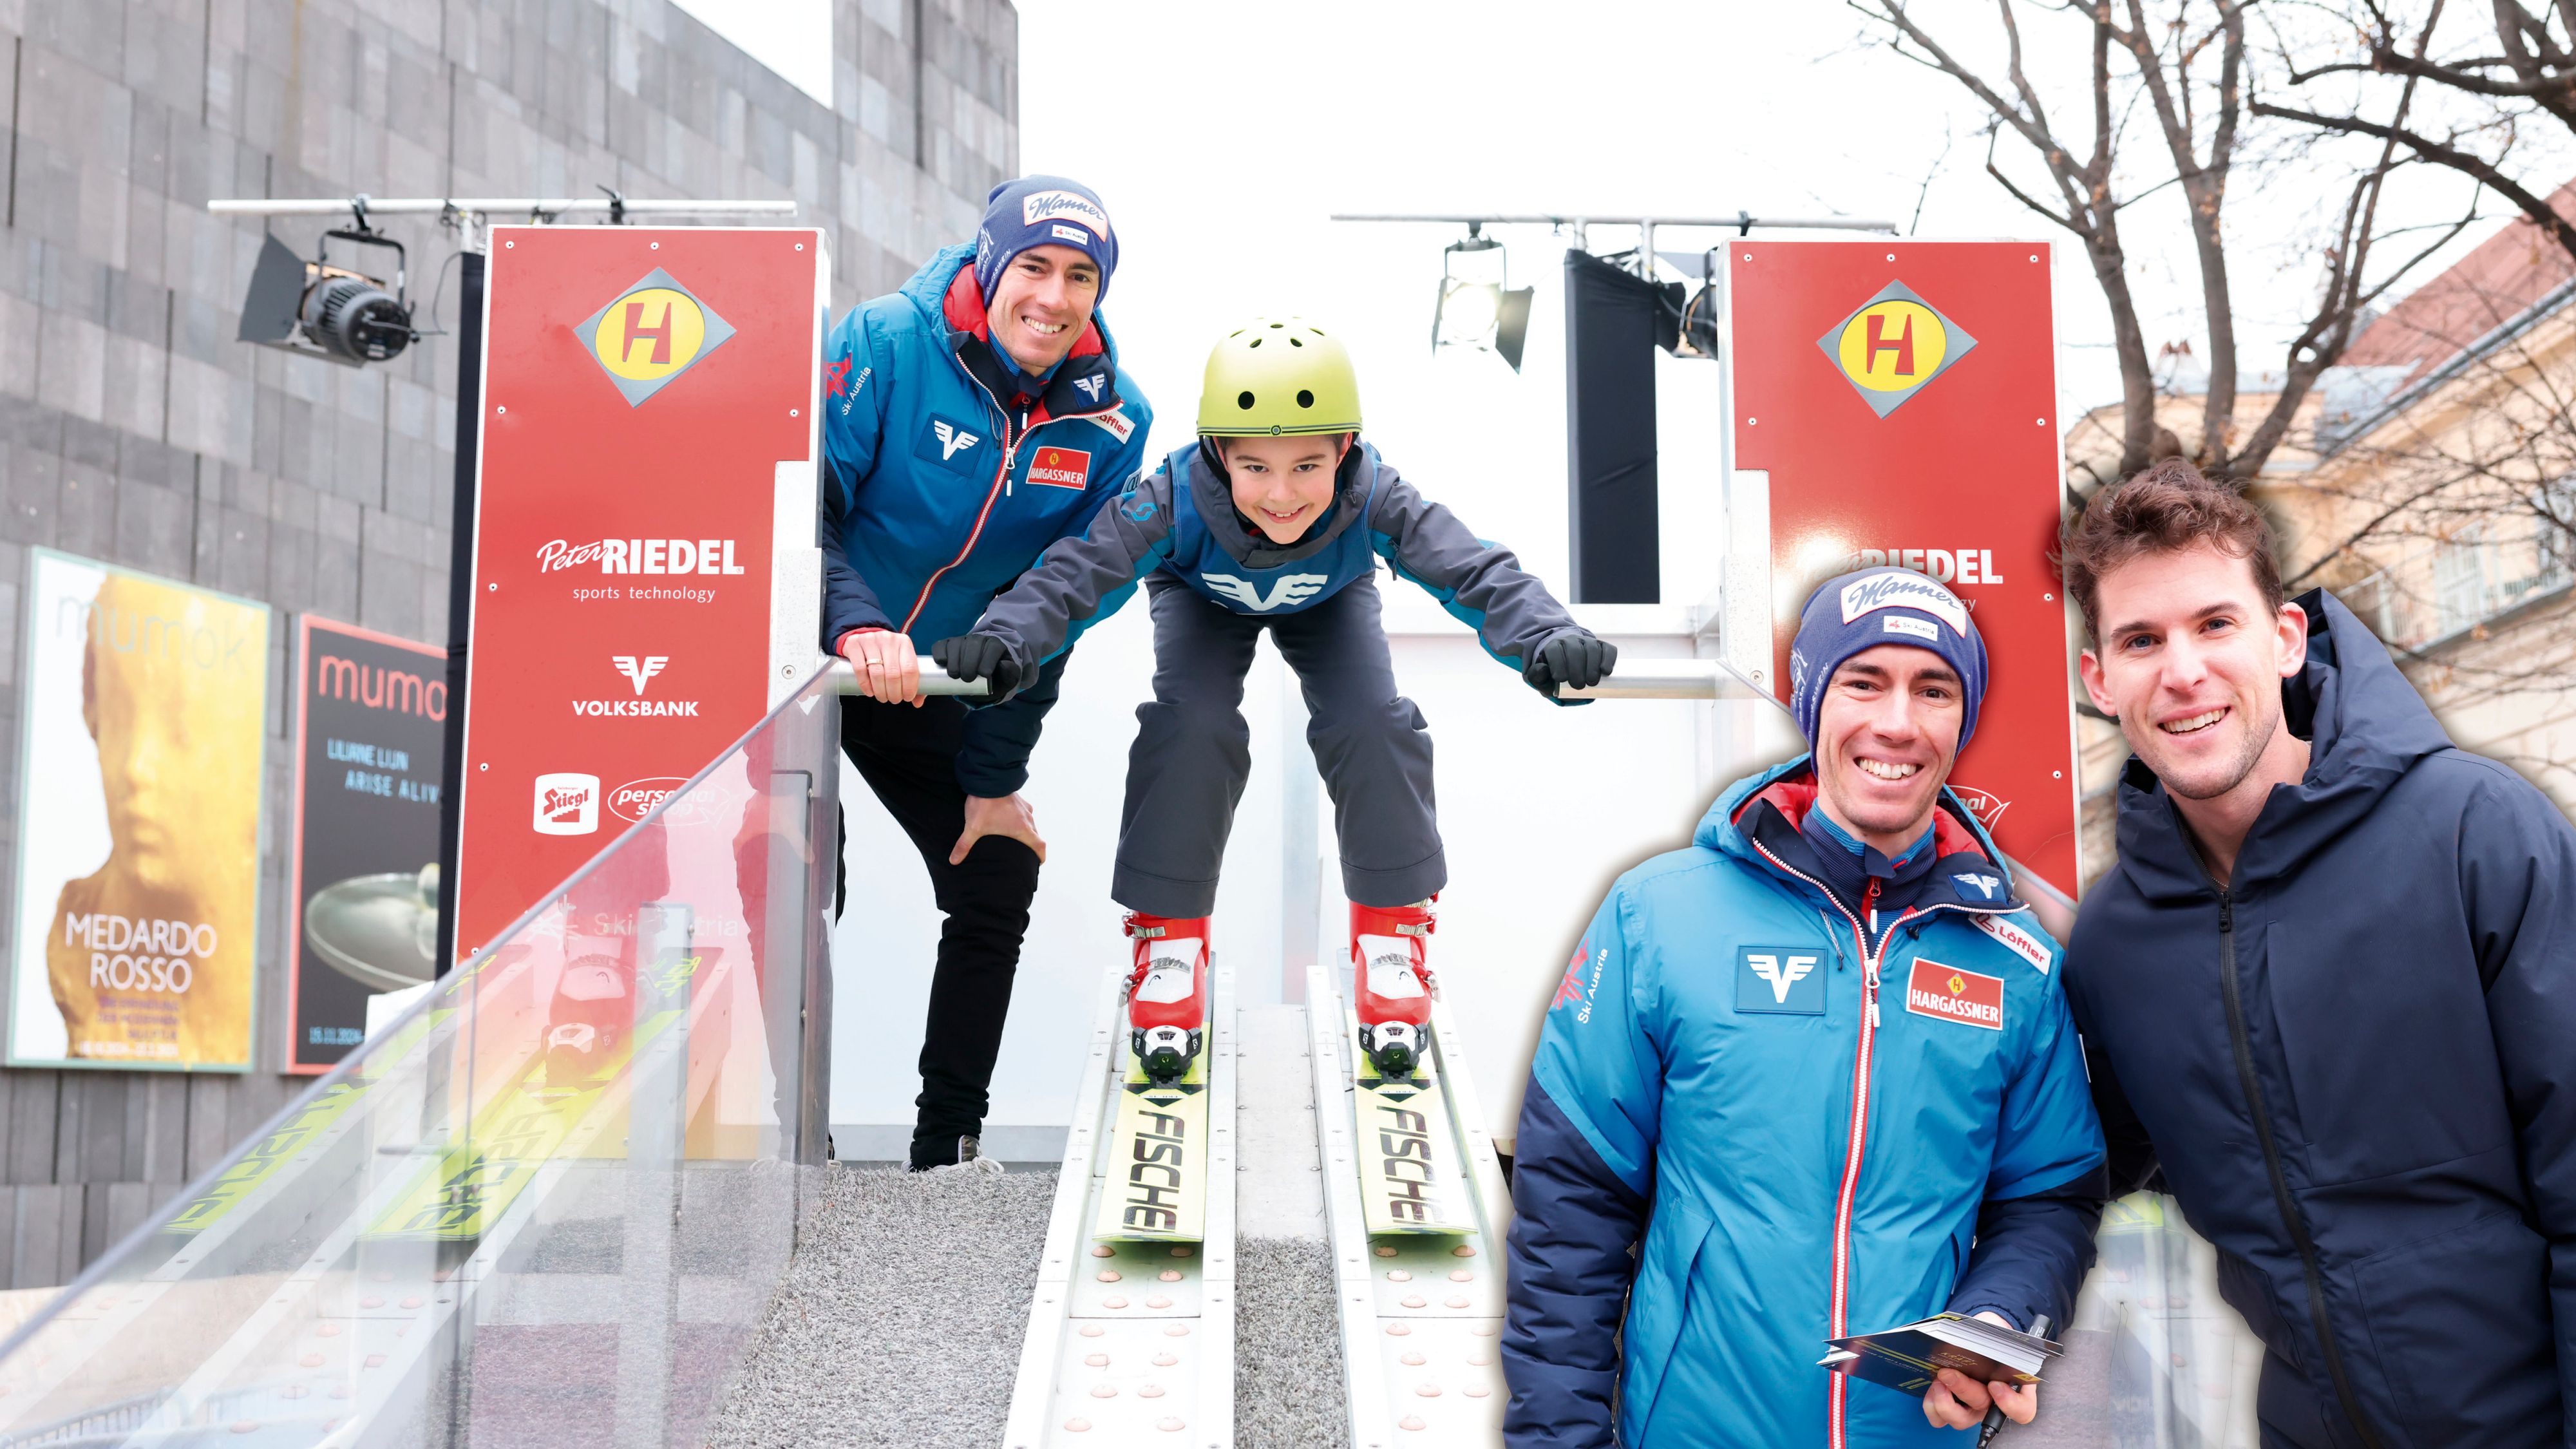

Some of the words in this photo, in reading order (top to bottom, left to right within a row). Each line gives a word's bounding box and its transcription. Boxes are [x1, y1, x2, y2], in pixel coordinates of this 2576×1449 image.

[1028, 193, 1104, 220] Manner
[621, 301, 672, 365] H
[1866, 314, 1915, 376] H
[842, 399, 853, 415] Ski
[849, 366, 872, 401] Austria
[1029, 467, 1084, 485] HARGASSNER
[536, 539, 609, 573] Peter
[601, 539, 744, 574] RIEDEL
[573, 586, 620, 602] sports
[629, 585, 716, 603] technology
[1848, 575, 1960, 614] Manner
[55, 594, 245, 677] mumok
[1914, 625, 1935, 635] Austria
[318, 655, 448, 722] mumo
[571, 700, 699, 717] VOLKSBANK
[345, 770, 393, 797] ARISE
[398, 779, 440, 803] ALIV
[543, 788, 589, 816] Stiegl
[66, 911, 217, 958] MEDARDO
[1998, 925, 2045, 963] Löffler
[90, 952, 193, 994] ROSSO
[1577, 1000, 1593, 1024] Ski
[1587, 948, 1608, 999] Austria
[1911, 989, 2000, 1023] HARGASSNER
[1122, 1110, 1185, 1233] FISCHE
[1376, 1105, 1446, 1225] FISCHE
